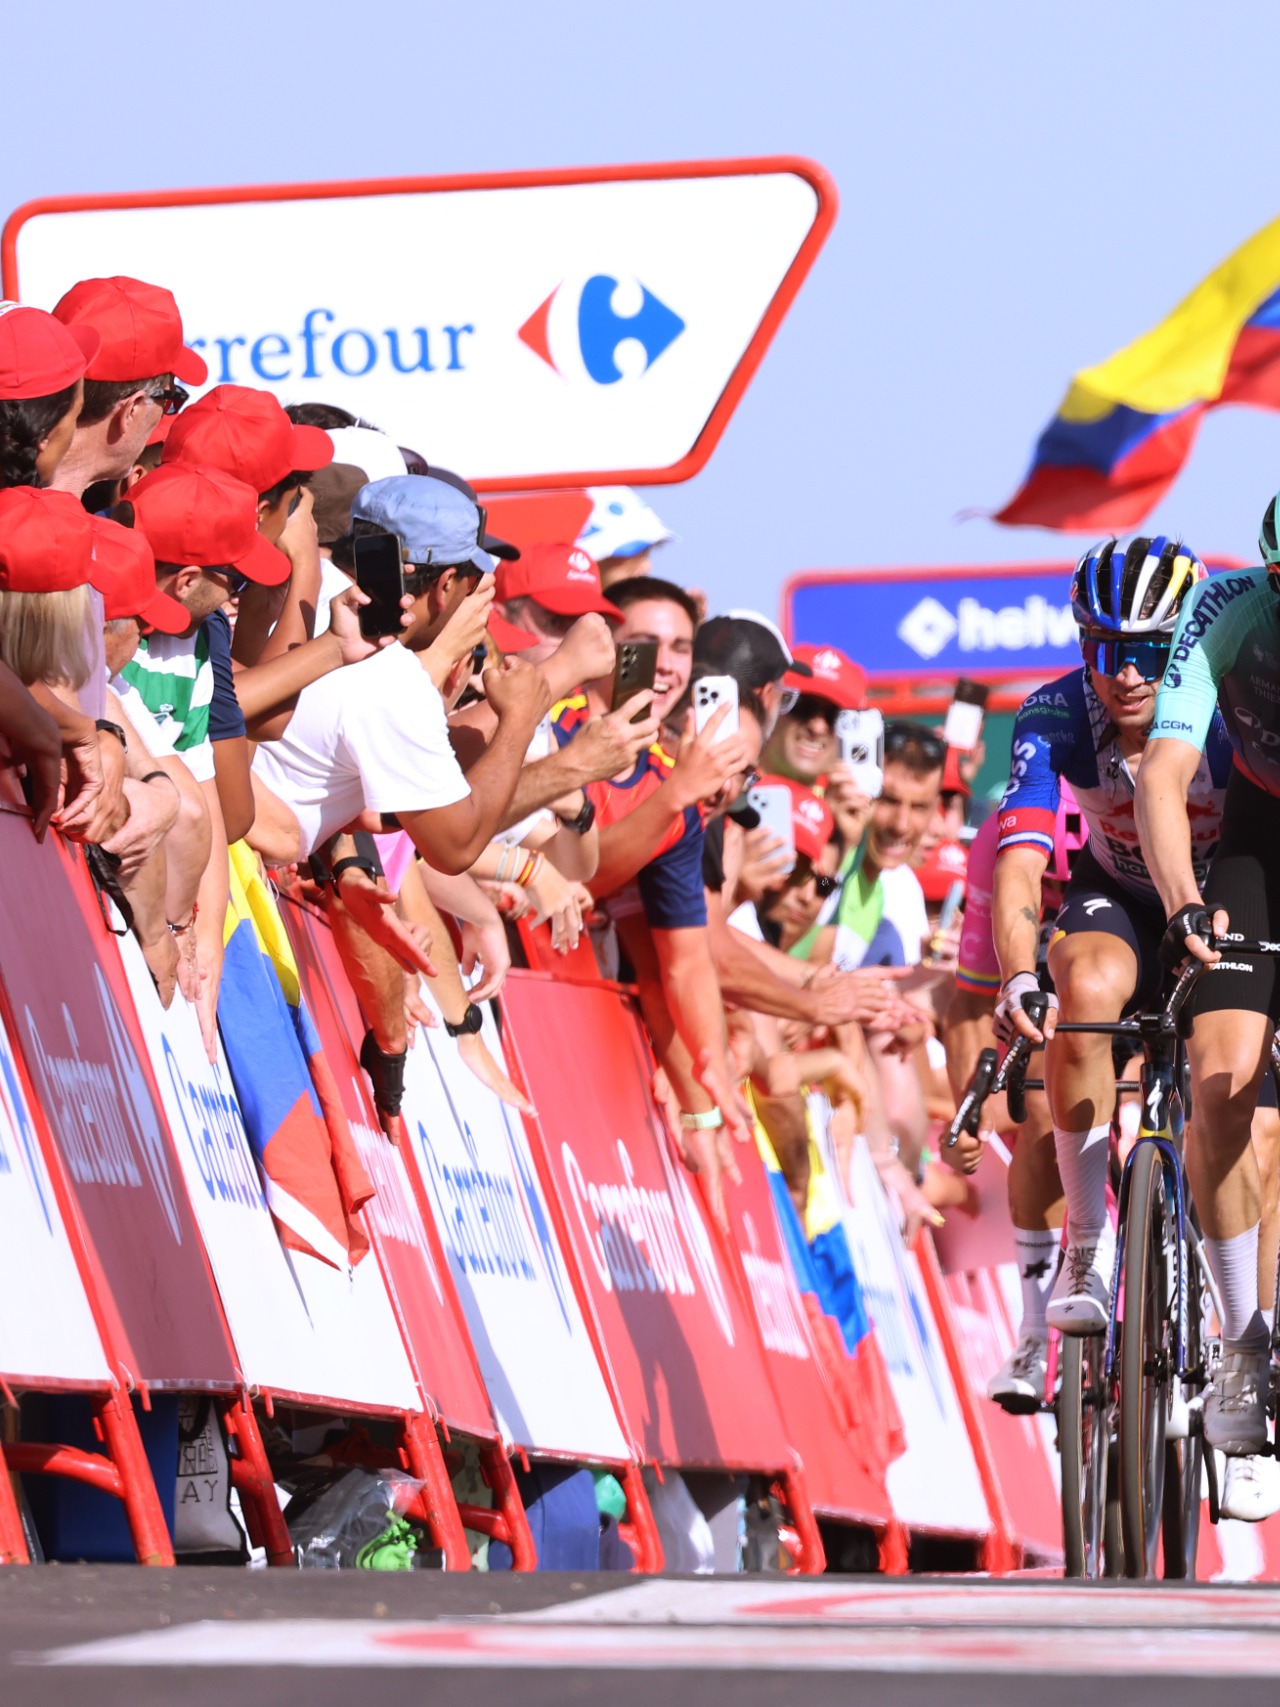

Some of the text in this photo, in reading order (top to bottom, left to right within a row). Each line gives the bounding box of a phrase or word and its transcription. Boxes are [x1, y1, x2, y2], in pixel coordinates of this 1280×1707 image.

[183, 308, 475, 384] refour
[957, 595, 1079, 651] helv
[1173, 575, 1257, 662] DECATHLON
[1161, 720, 1193, 733] CGM
[1212, 961, 1253, 973] ATHLON
